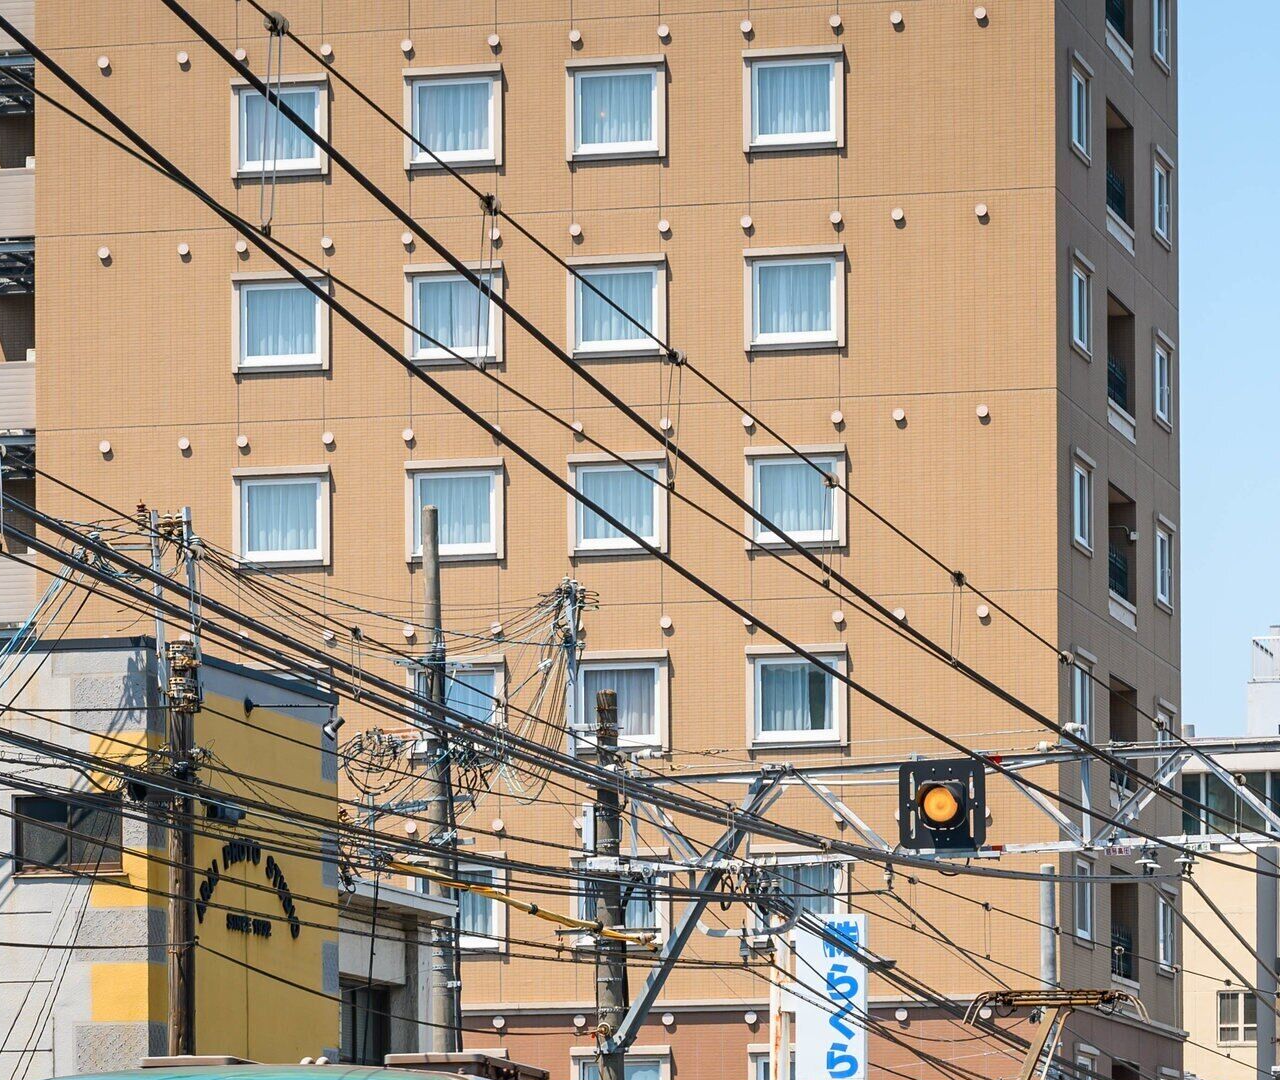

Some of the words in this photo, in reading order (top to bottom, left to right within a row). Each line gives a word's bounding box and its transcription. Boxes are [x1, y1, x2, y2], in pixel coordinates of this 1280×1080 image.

[222, 838, 261, 870] PHOTO
[265, 855, 300, 939] STUDIO
[226, 912, 251, 934] SINCE
